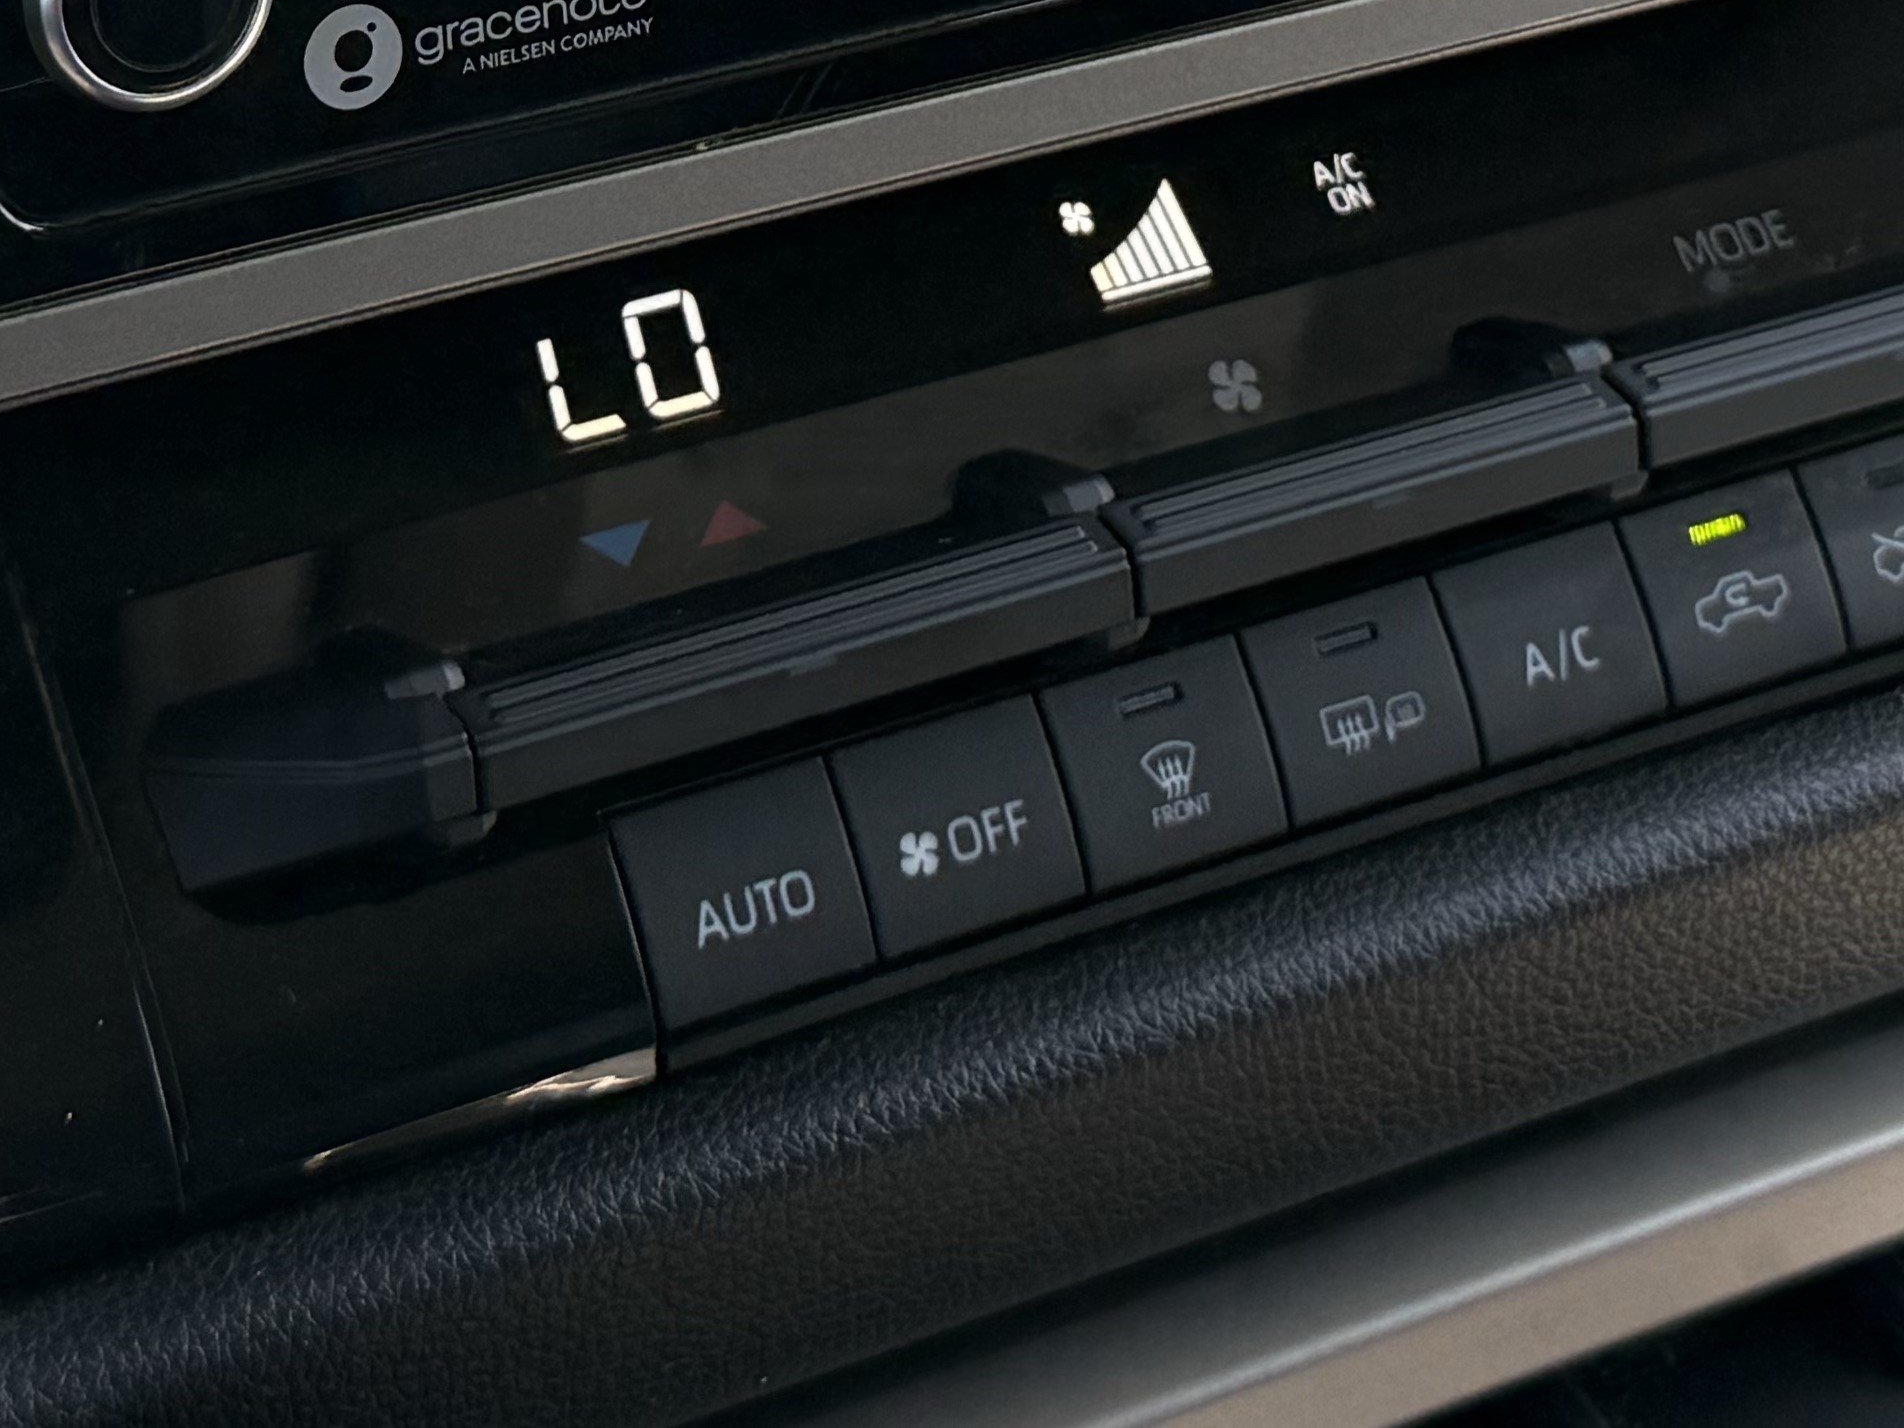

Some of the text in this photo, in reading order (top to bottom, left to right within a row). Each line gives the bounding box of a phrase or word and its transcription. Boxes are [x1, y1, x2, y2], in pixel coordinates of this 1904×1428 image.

[463, 17, 653, 74] A NIELSEN COMPANY
[1314, 153, 1364, 190] A/C
[1328, 182, 1374, 213] ON
[1673, 210, 1794, 273] MODE
[1525, 626, 1600, 686] A/C
[948, 799, 1029, 864] OFF
[1152, 792, 1212, 828] FRONT
[697, 869, 815, 948] AUTO
